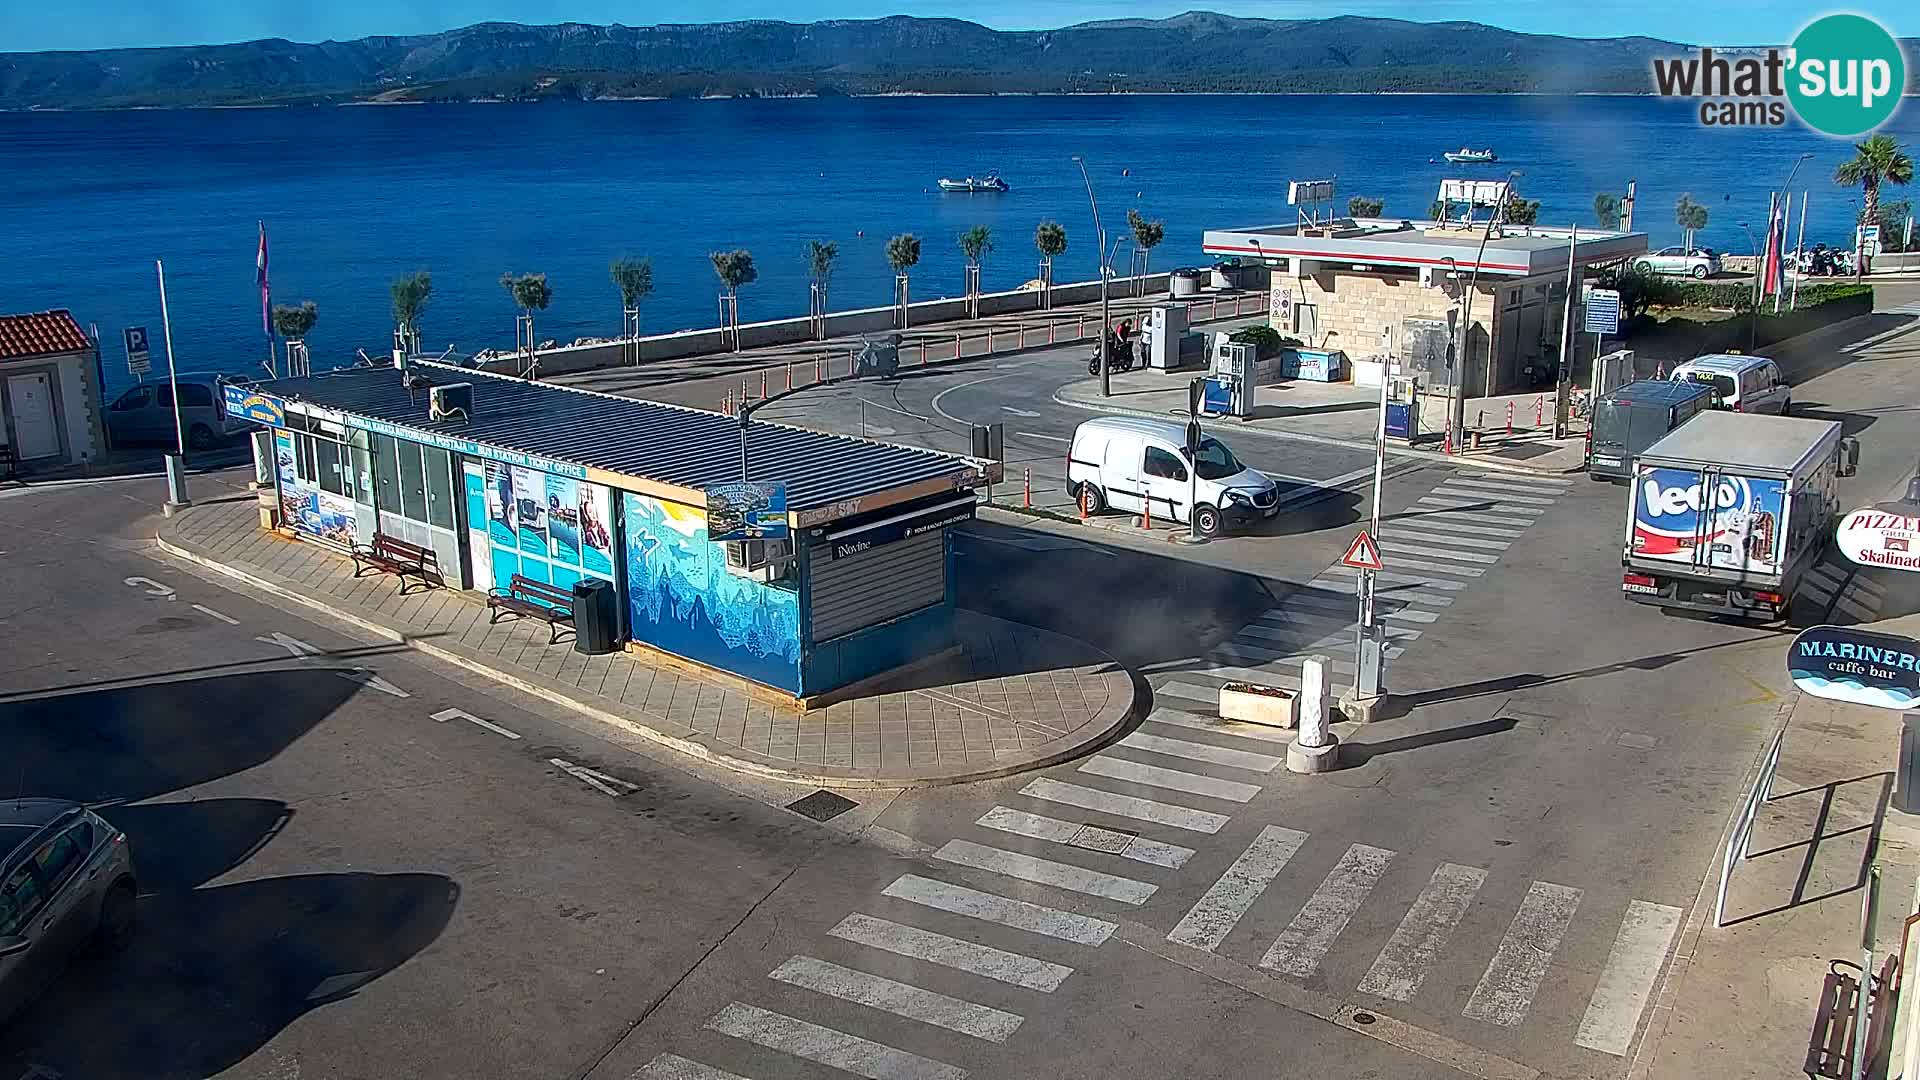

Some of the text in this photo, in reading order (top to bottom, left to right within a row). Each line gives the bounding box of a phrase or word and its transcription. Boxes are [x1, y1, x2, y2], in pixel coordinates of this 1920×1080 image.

[1696, 372, 1714, 381] TAXI
[436, 435, 467, 452] POSTAJA
[478, 445, 493, 457] BUS
[493, 449, 526, 464] STATION
[528, 456, 554, 470] TICKET
[554, 462, 583, 476] OFFICE
[1643, 479, 1737, 517] ledo
[838, 540, 871, 558] iNovine
[1828, 661, 1896, 680] caffe bar
